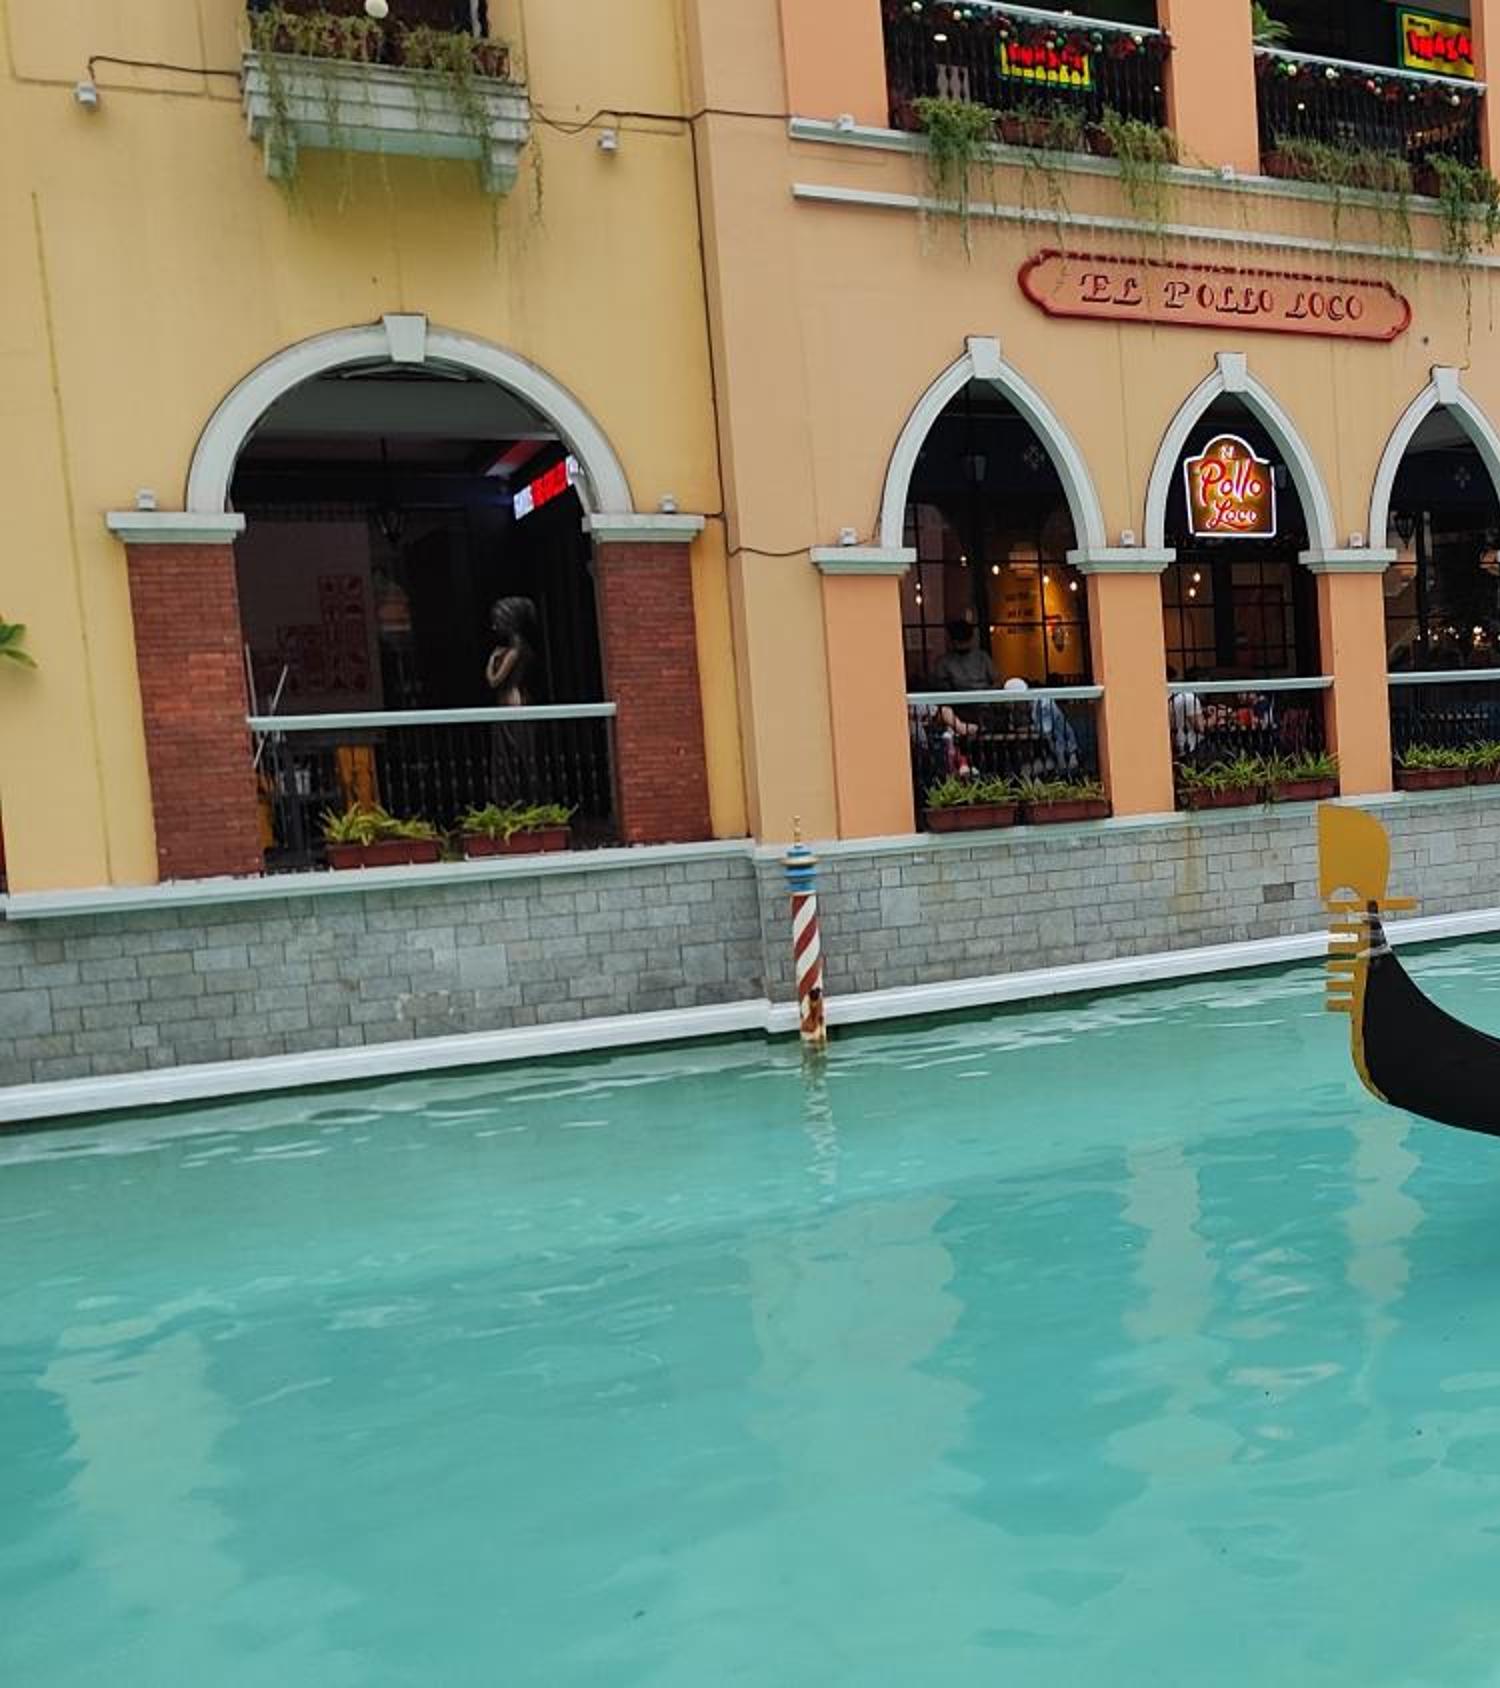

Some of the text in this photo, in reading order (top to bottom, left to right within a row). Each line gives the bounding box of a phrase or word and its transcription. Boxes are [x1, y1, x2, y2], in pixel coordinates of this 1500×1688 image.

[1080, 273, 1363, 320] EL POLLO LOCO
[1199, 457, 1264, 506] Pollo
